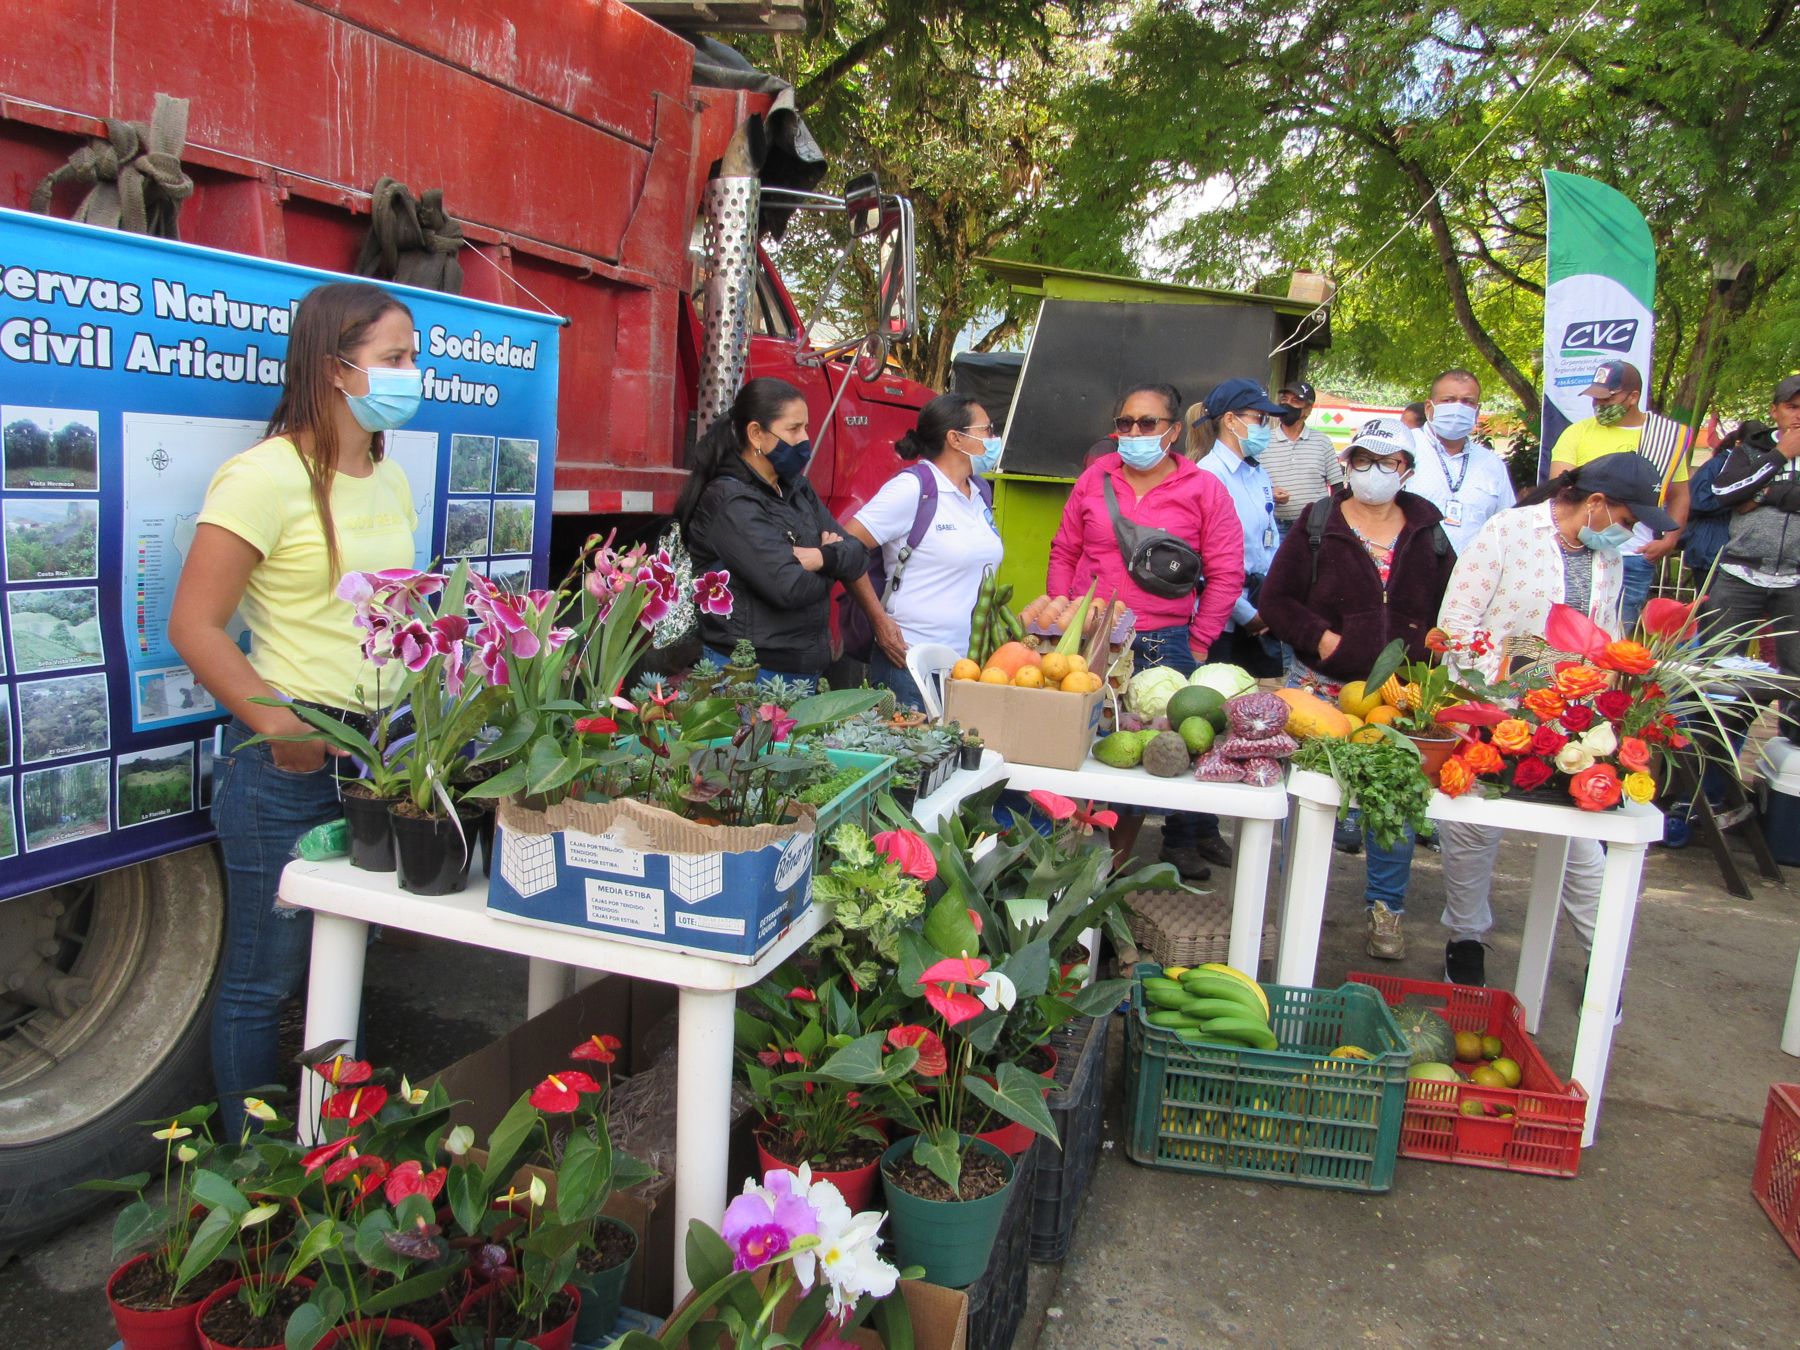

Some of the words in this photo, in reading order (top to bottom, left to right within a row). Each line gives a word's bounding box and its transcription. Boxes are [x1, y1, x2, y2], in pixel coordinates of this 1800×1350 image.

[0, 264, 143, 316] ervas
[1565, 322, 1635, 347] CVC
[0, 317, 112, 369] Civil
[429, 324, 538, 371] Sociedad
[421, 366, 500, 407] futuro
[935, 524, 957, 532] ISABEL
[54, 658, 69, 666] Vista
[570, 848, 598, 857] TENDIDOS:
[600, 860, 619, 868] ESTIBA:
[597, 885, 623, 896] MEDIA
[625, 889, 652, 900] ESTIBA
[592, 897, 608, 905] CAJAS
[620, 901, 645, 911] TENDIDO:
[592, 905, 619, 914] TENDIDOS:
[592, 912, 608, 920] CAJAS
[621, 917, 640, 925] ESTIBA:
[678, 916, 698, 926] LOTE:
[760, 900, 789, 930] DETERGENTE
